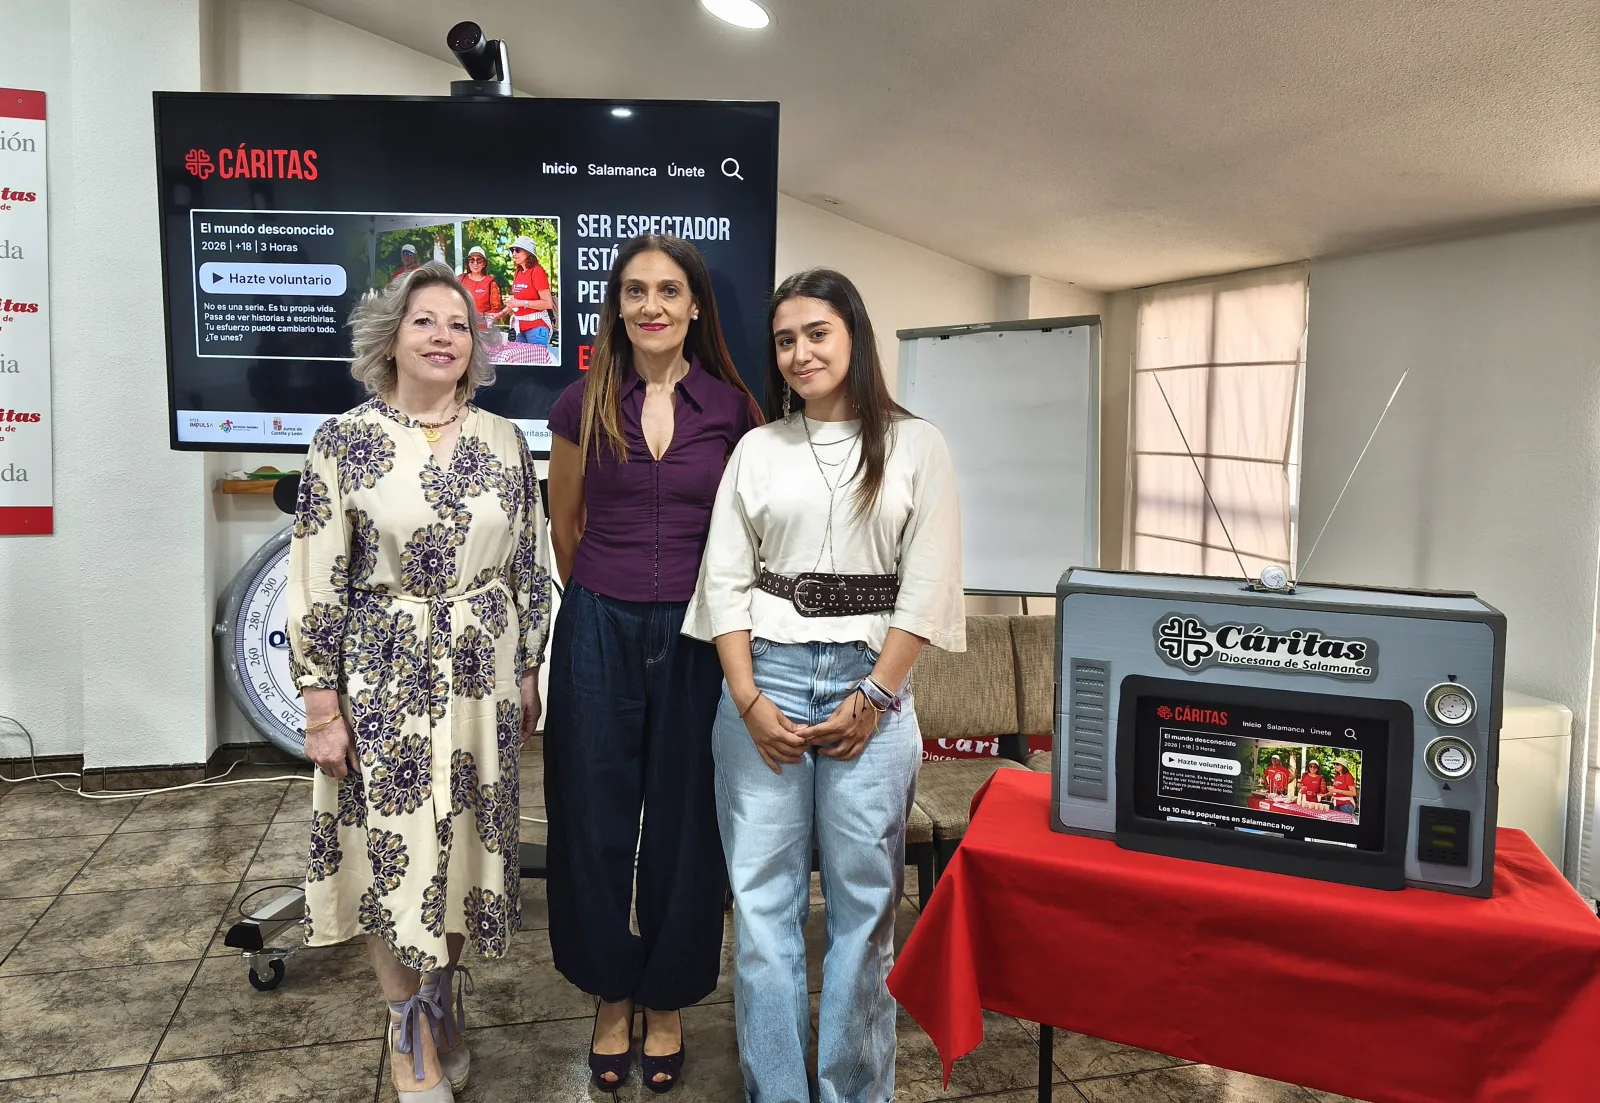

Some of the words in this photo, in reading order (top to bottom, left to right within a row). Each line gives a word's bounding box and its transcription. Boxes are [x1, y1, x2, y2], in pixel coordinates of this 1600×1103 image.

[218, 143, 318, 181] CÁRITAS
[542, 162, 578, 175] Inicio
[587, 163, 657, 177] Salamanca
[667, 162, 705, 178] Únete
[200, 223, 212, 234] El
[214, 223, 255, 235] mundo
[257, 224, 335, 236] desconocido
[577, 213, 611, 238] SER
[616, 214, 730, 241] ESPECTADOR
[201, 241, 227, 251] 2026
[235, 242, 252, 251] +18
[260, 243, 267, 252] 3
[269, 243, 298, 252] Horas
[229, 273, 266, 284] Hazte
[269, 274, 332, 286] voluntario
[204, 303, 216, 311] No
[245, 303, 267, 312] serie.
[268, 304, 278, 312] Es
[279, 304, 288, 312] tu
[289, 304, 315, 314] propia
[316, 304, 336, 313] vida.
[204, 313, 224, 321] Pasa
[225, 313, 236, 321] de
[251, 314, 285, 322] historias
[293, 315, 336, 323] escribirlas.
[205, 323, 215, 331] Tu
[216, 323, 250, 332] esfuerzo
[251, 324, 276, 333] puede
[277, 325, 316, 333] cambiarlo
[317, 325, 337, 334] todo.
[205, 334, 218, 342] ¿Te
[220, 334, 243, 342] unes?
[261, 577, 278, 597] 300
[248, 611, 262, 631] 280
[1215, 625, 1366, 661] Cáritas
[250, 647, 261, 666] 260
[1219, 652, 1281, 668] Diocesana
[1284, 658, 1299, 669] de
[1302, 660, 1371, 676] Salamanca
[258, 682, 276, 700] 240
[281, 710, 300, 727] 220
[1175, 705, 1228, 726] CÁRITAS
[1242, 721, 1262, 729] Inicio
[1266, 723, 1305, 733] Salamanca
[1310, 727, 1332, 736] Únete
[1194, 736, 1237, 747] desconocido
[1177, 758, 1197, 767] Hazte
[1198, 761, 1234, 771] voluntario
[1158, 805, 1171, 813] Los
[1181, 808, 1195, 816] más
[1196, 811, 1230, 822] populares
[1241, 817, 1280, 829] Salamanca
[1281, 823, 1295, 832] hoy
